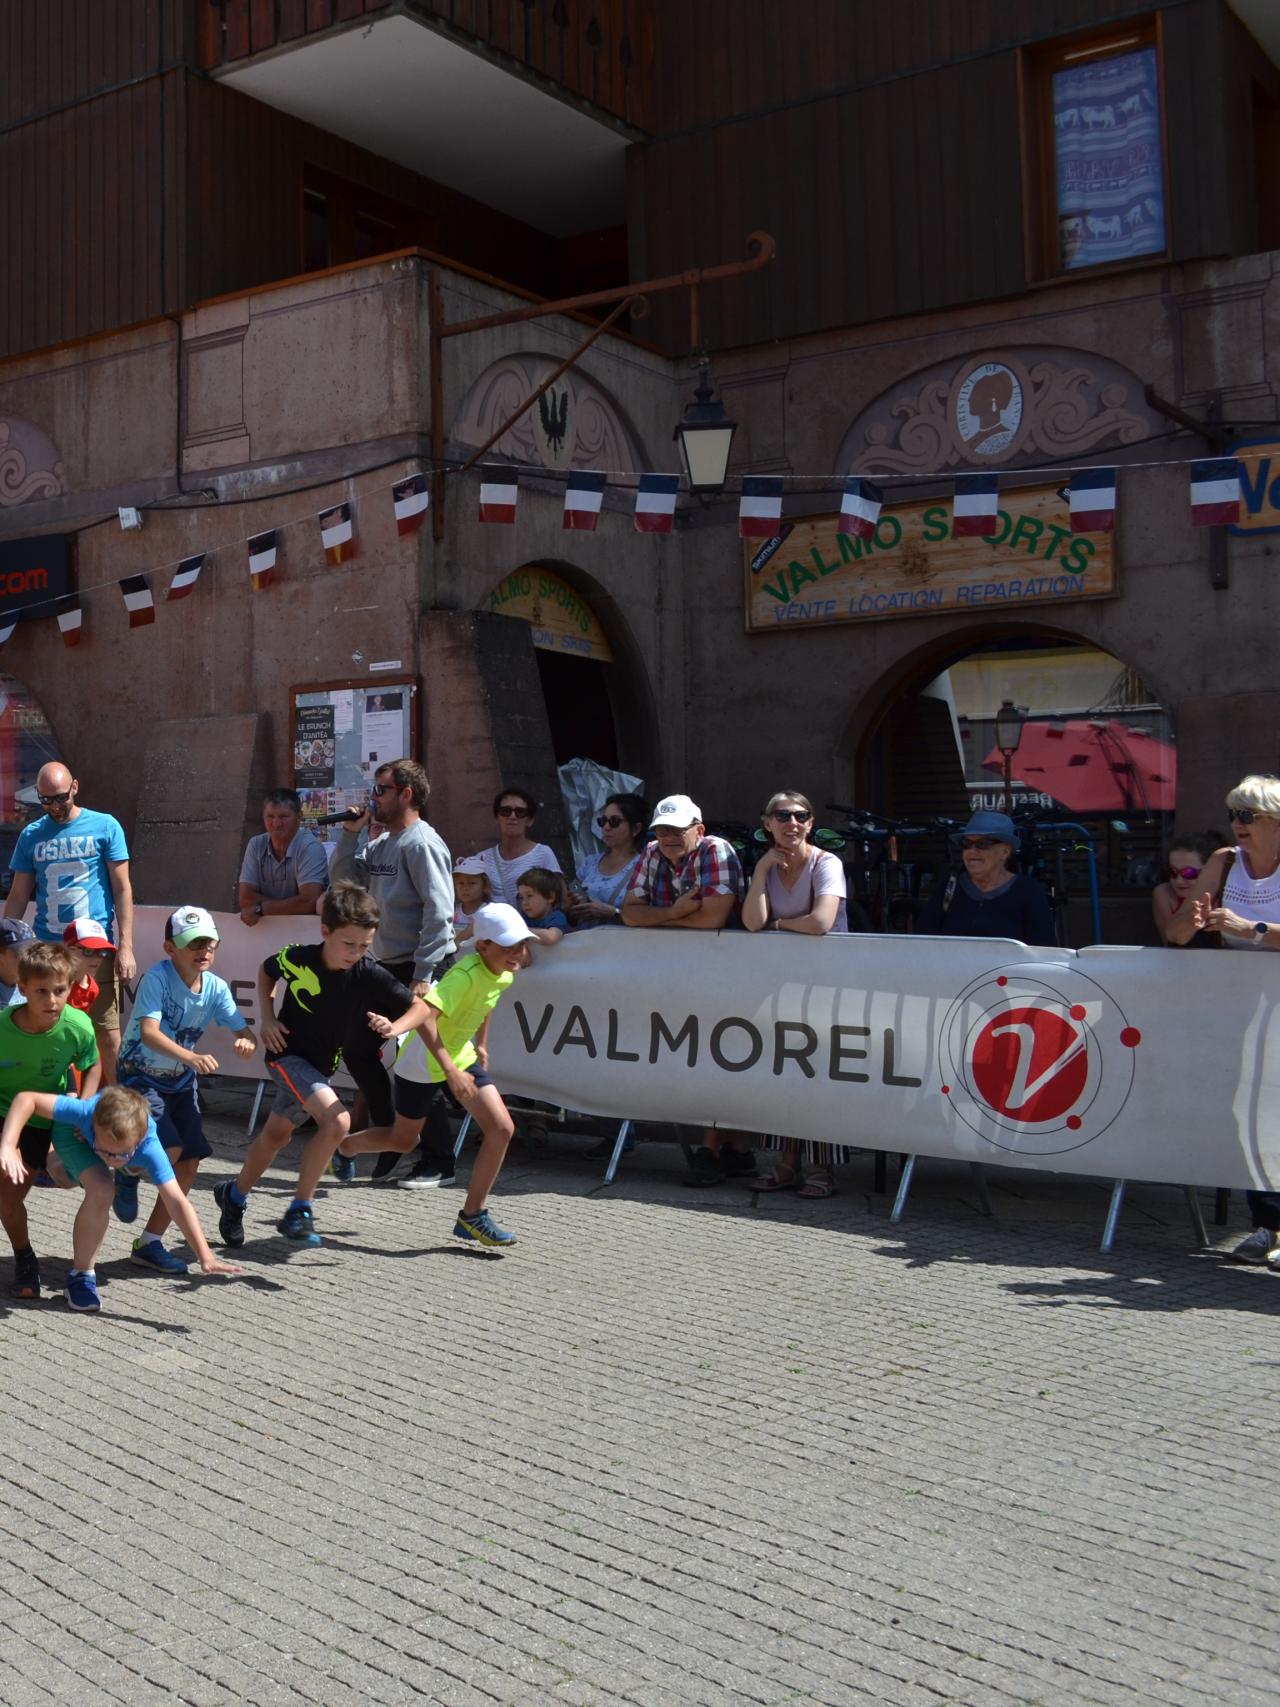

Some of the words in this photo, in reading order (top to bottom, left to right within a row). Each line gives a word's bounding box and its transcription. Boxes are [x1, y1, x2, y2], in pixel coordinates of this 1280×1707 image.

[762, 515, 903, 606] VALMO
[922, 507, 1097, 575] SORTS
[490, 574, 531, 612] ALMO
[774, 600, 837, 625] VENTE
[847, 587, 944, 616] LOCATION
[956, 573, 1086, 606] REPARATION
[34, 835, 97, 862] OSAKA
[512, 1000, 923, 1088] VALMOREL
